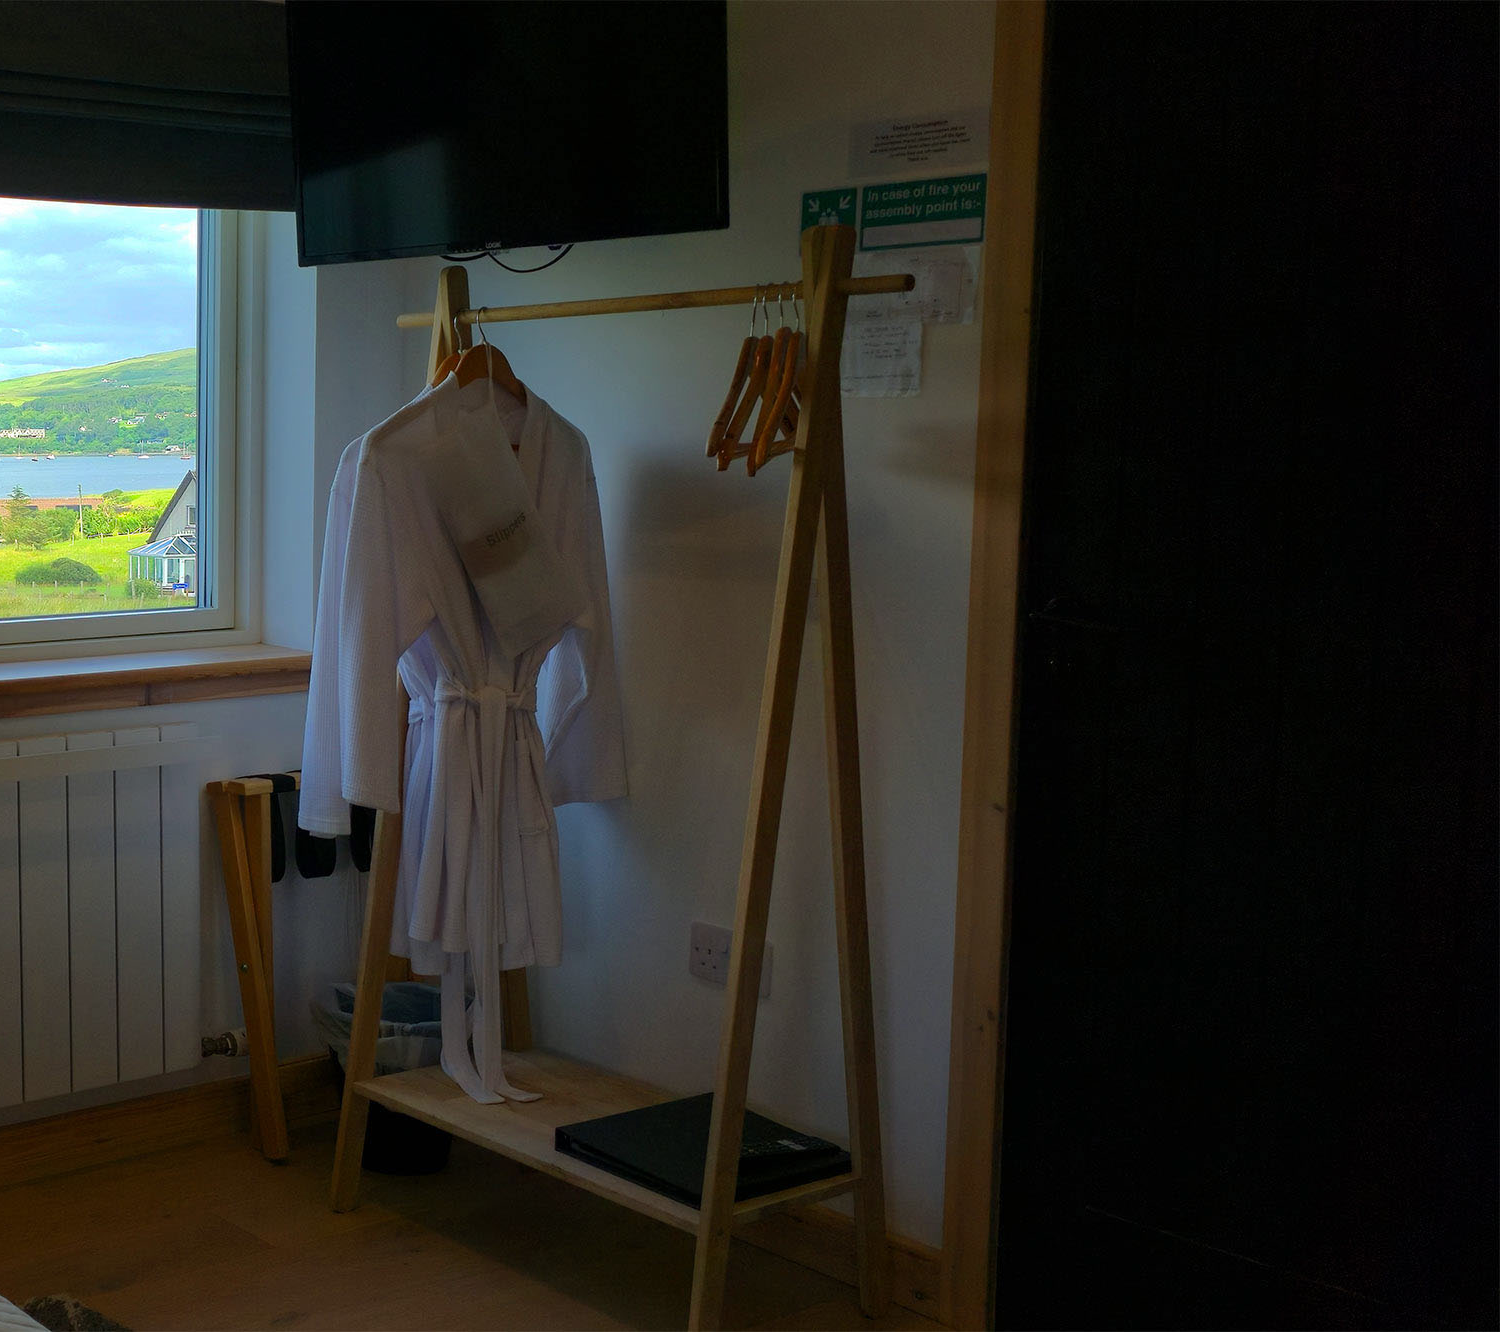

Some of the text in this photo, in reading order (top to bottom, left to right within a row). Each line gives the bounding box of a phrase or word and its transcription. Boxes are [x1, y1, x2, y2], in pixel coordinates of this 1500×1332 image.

[882, 189, 910, 201] case
[913, 186, 925, 198] of
[928, 184, 949, 196] fire
[952, 182, 980, 196] your
[866, 203, 922, 218] assembly
[926, 200, 958, 215] point
